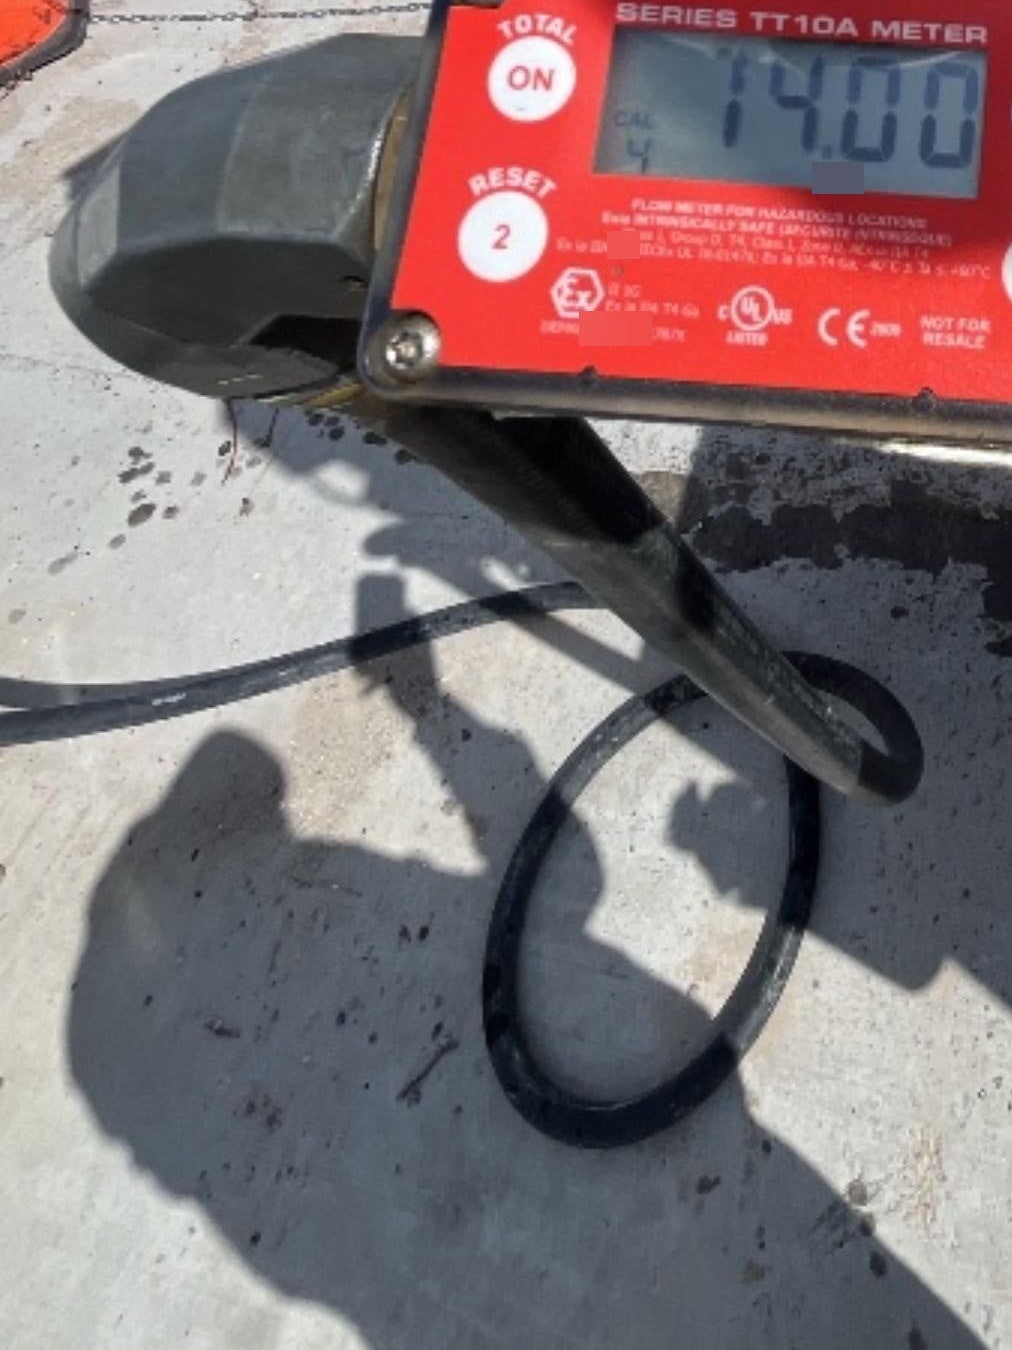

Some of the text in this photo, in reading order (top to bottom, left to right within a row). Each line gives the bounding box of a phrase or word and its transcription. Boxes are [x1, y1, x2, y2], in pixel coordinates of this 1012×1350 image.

[497, 13, 576, 45] TOTAL
[615, 2, 989, 43] SERIES TT10A METER
[507, 65, 555, 91] ON
[468, 167, 557, 199] RESET
[631, 198, 928, 229] FLOW METER FOR HAZARDOUS LOCATIONS
[491, 224, 511, 250] 2
[920, 314, 954, 332] NOT
[959, 317, 991, 334] FOR
[922, 331, 986, 349] RESALE
